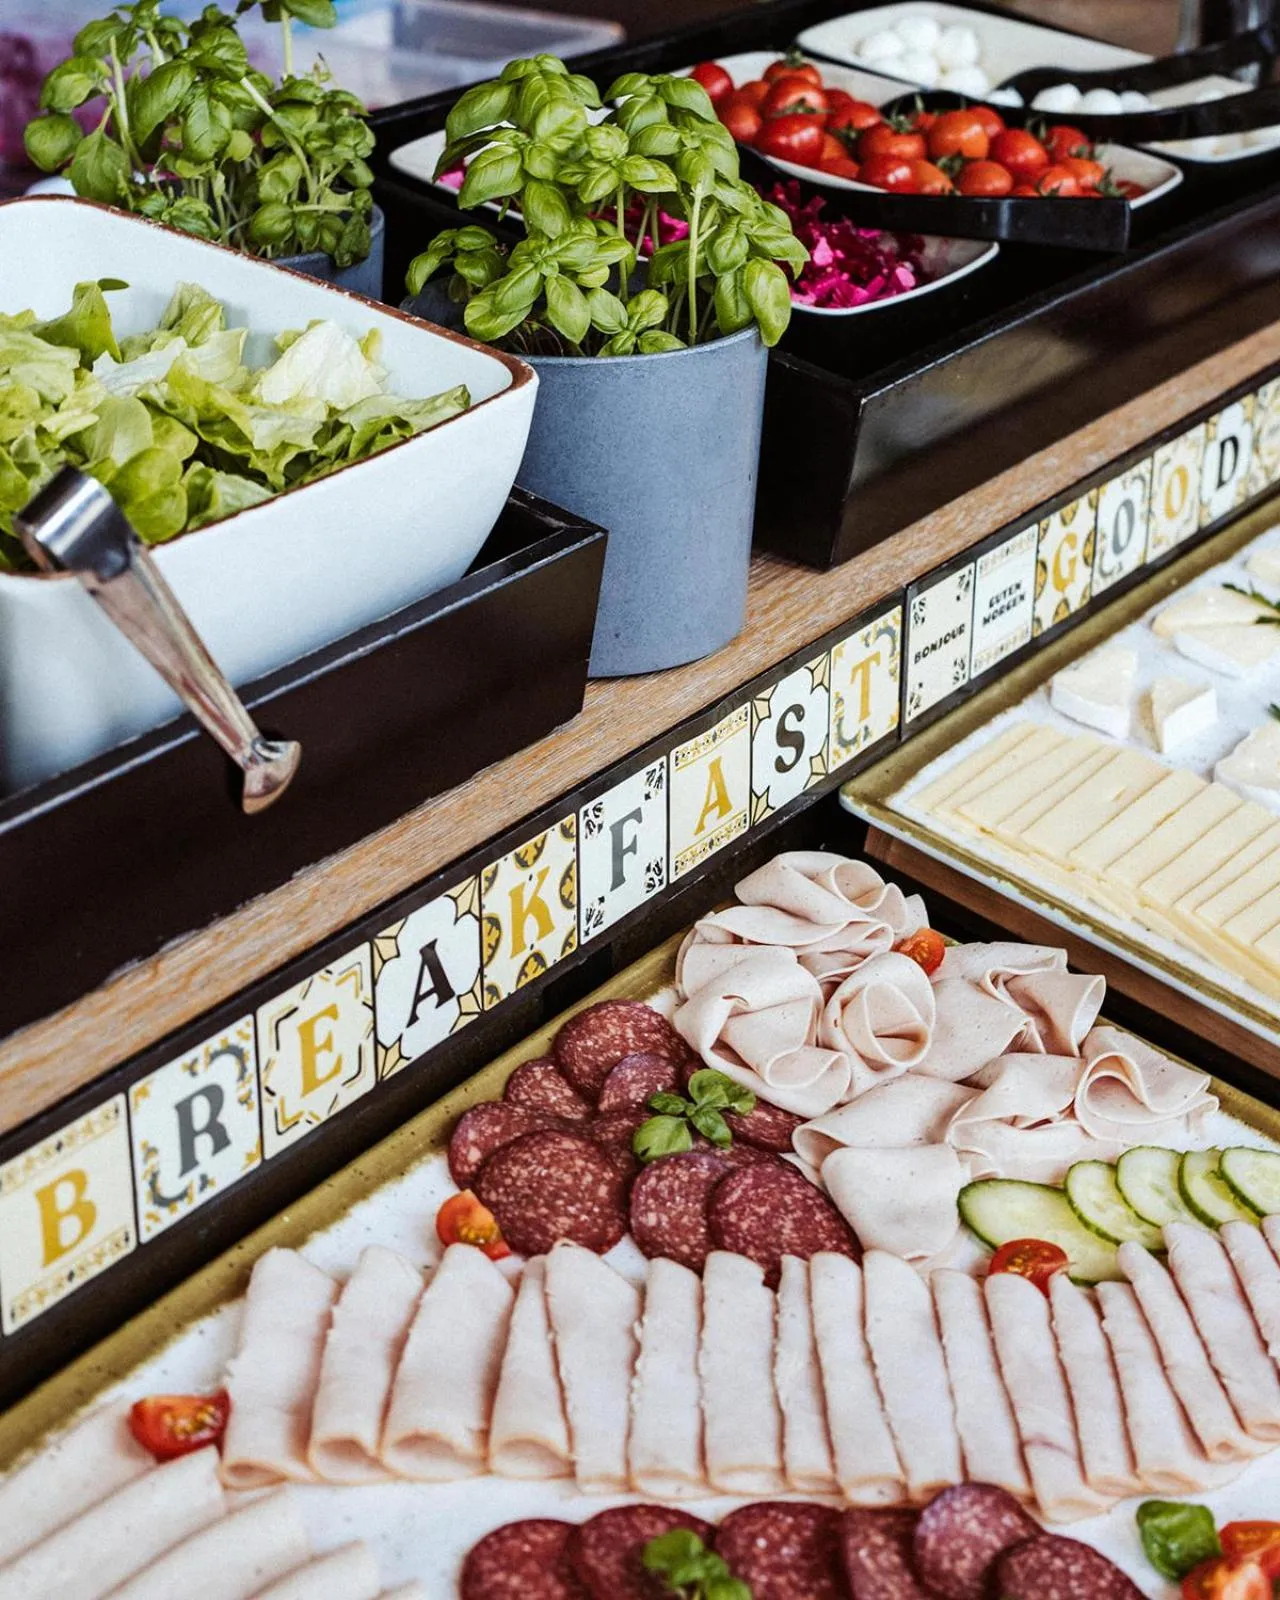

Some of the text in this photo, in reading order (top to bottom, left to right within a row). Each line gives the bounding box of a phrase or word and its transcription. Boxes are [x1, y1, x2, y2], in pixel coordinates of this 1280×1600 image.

[1053, 435, 1239, 592] GOOD
[982, 593, 1025, 627] MORGEN
[989, 581, 1021, 608] GUTEN
[914, 623, 965, 664] BONJOUR
[34, 650, 881, 1268] BREAKFAST
